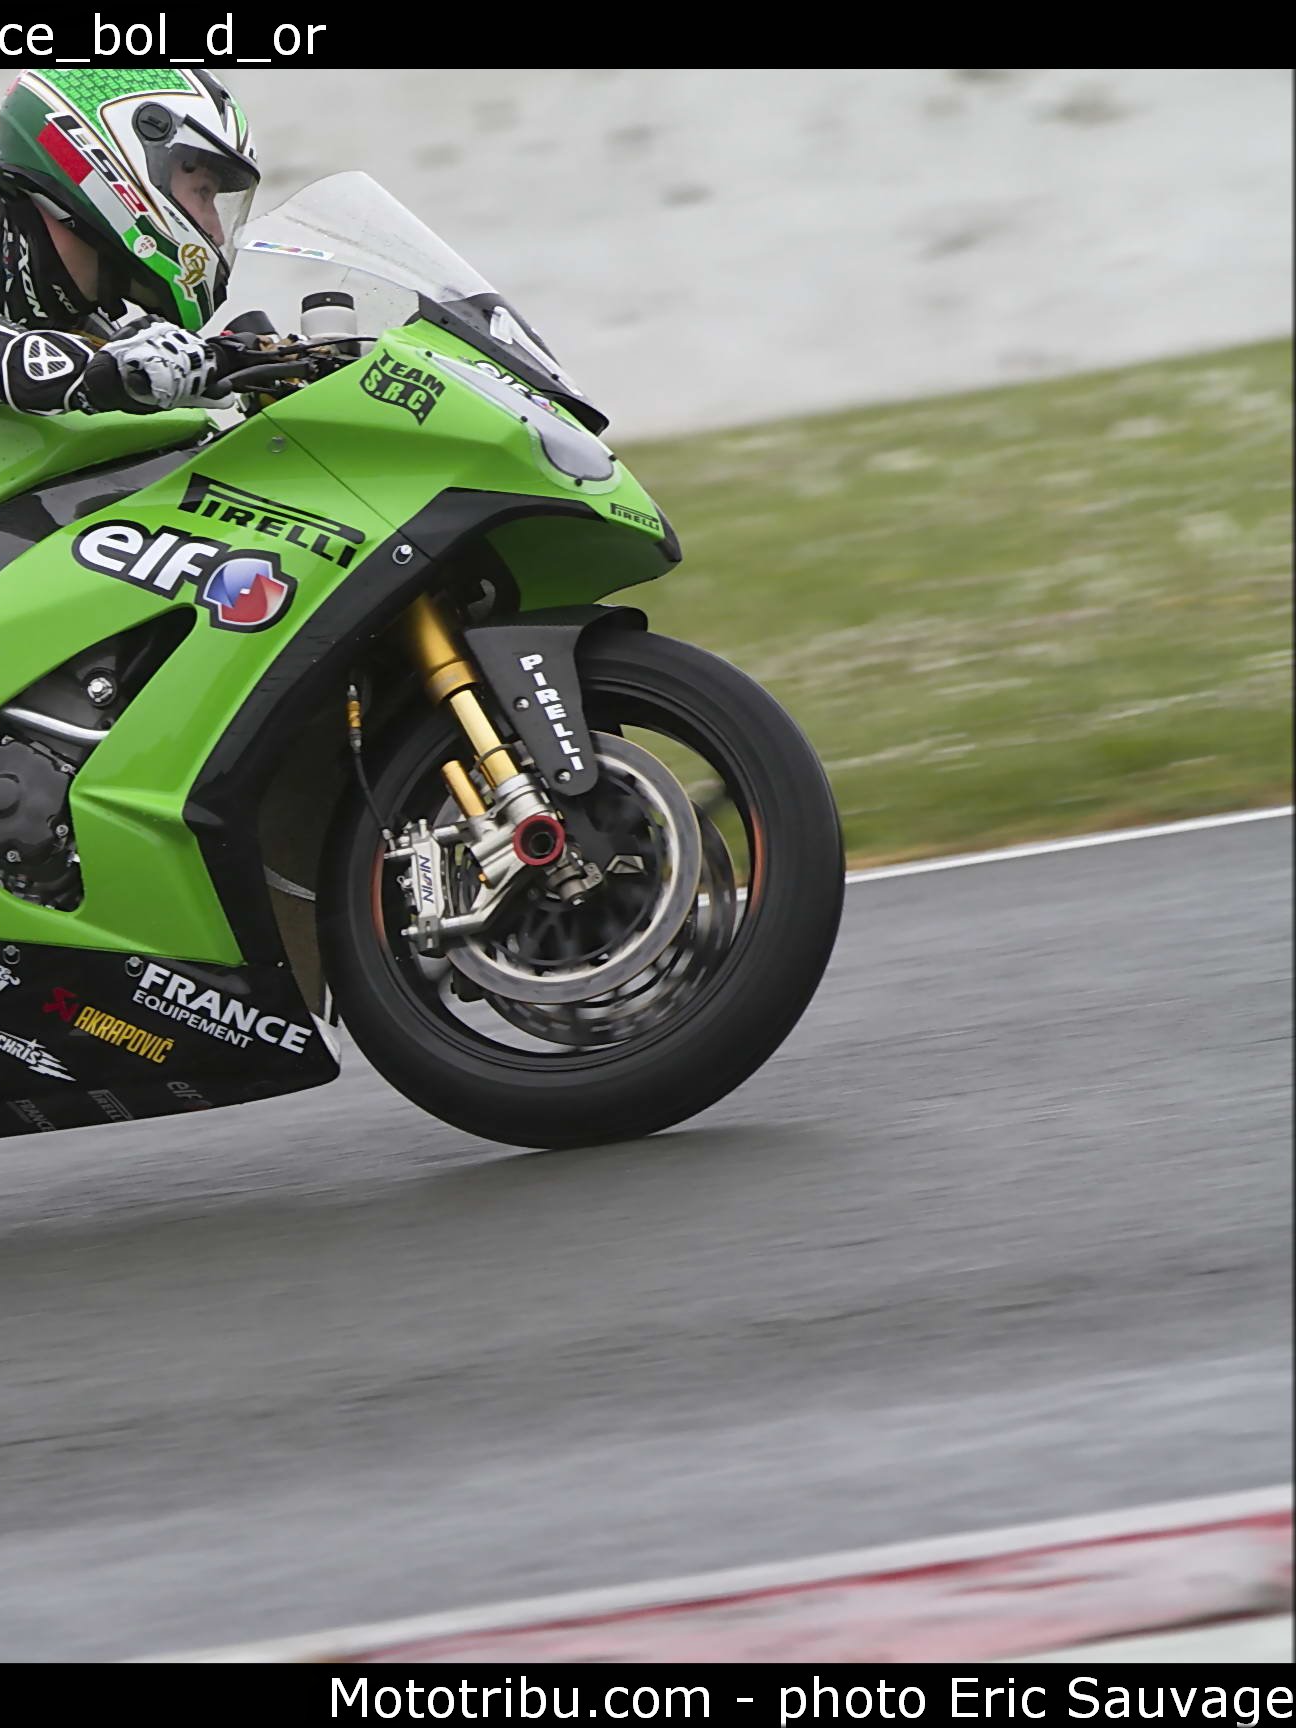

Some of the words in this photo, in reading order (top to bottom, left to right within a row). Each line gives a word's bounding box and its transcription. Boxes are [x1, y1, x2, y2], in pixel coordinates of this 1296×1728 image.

[52, 114, 149, 215] LS2
[378, 348, 446, 398] TEAM
[177, 472, 366, 569] PIRELLI
[609, 502, 660, 531] PIRELLI
[79, 525, 219, 592] elf
[519, 653, 585, 771] PIRELLI
[132, 989, 254, 1049] EQUIPEMENT
[138, 962, 312, 1055] FRANCE
